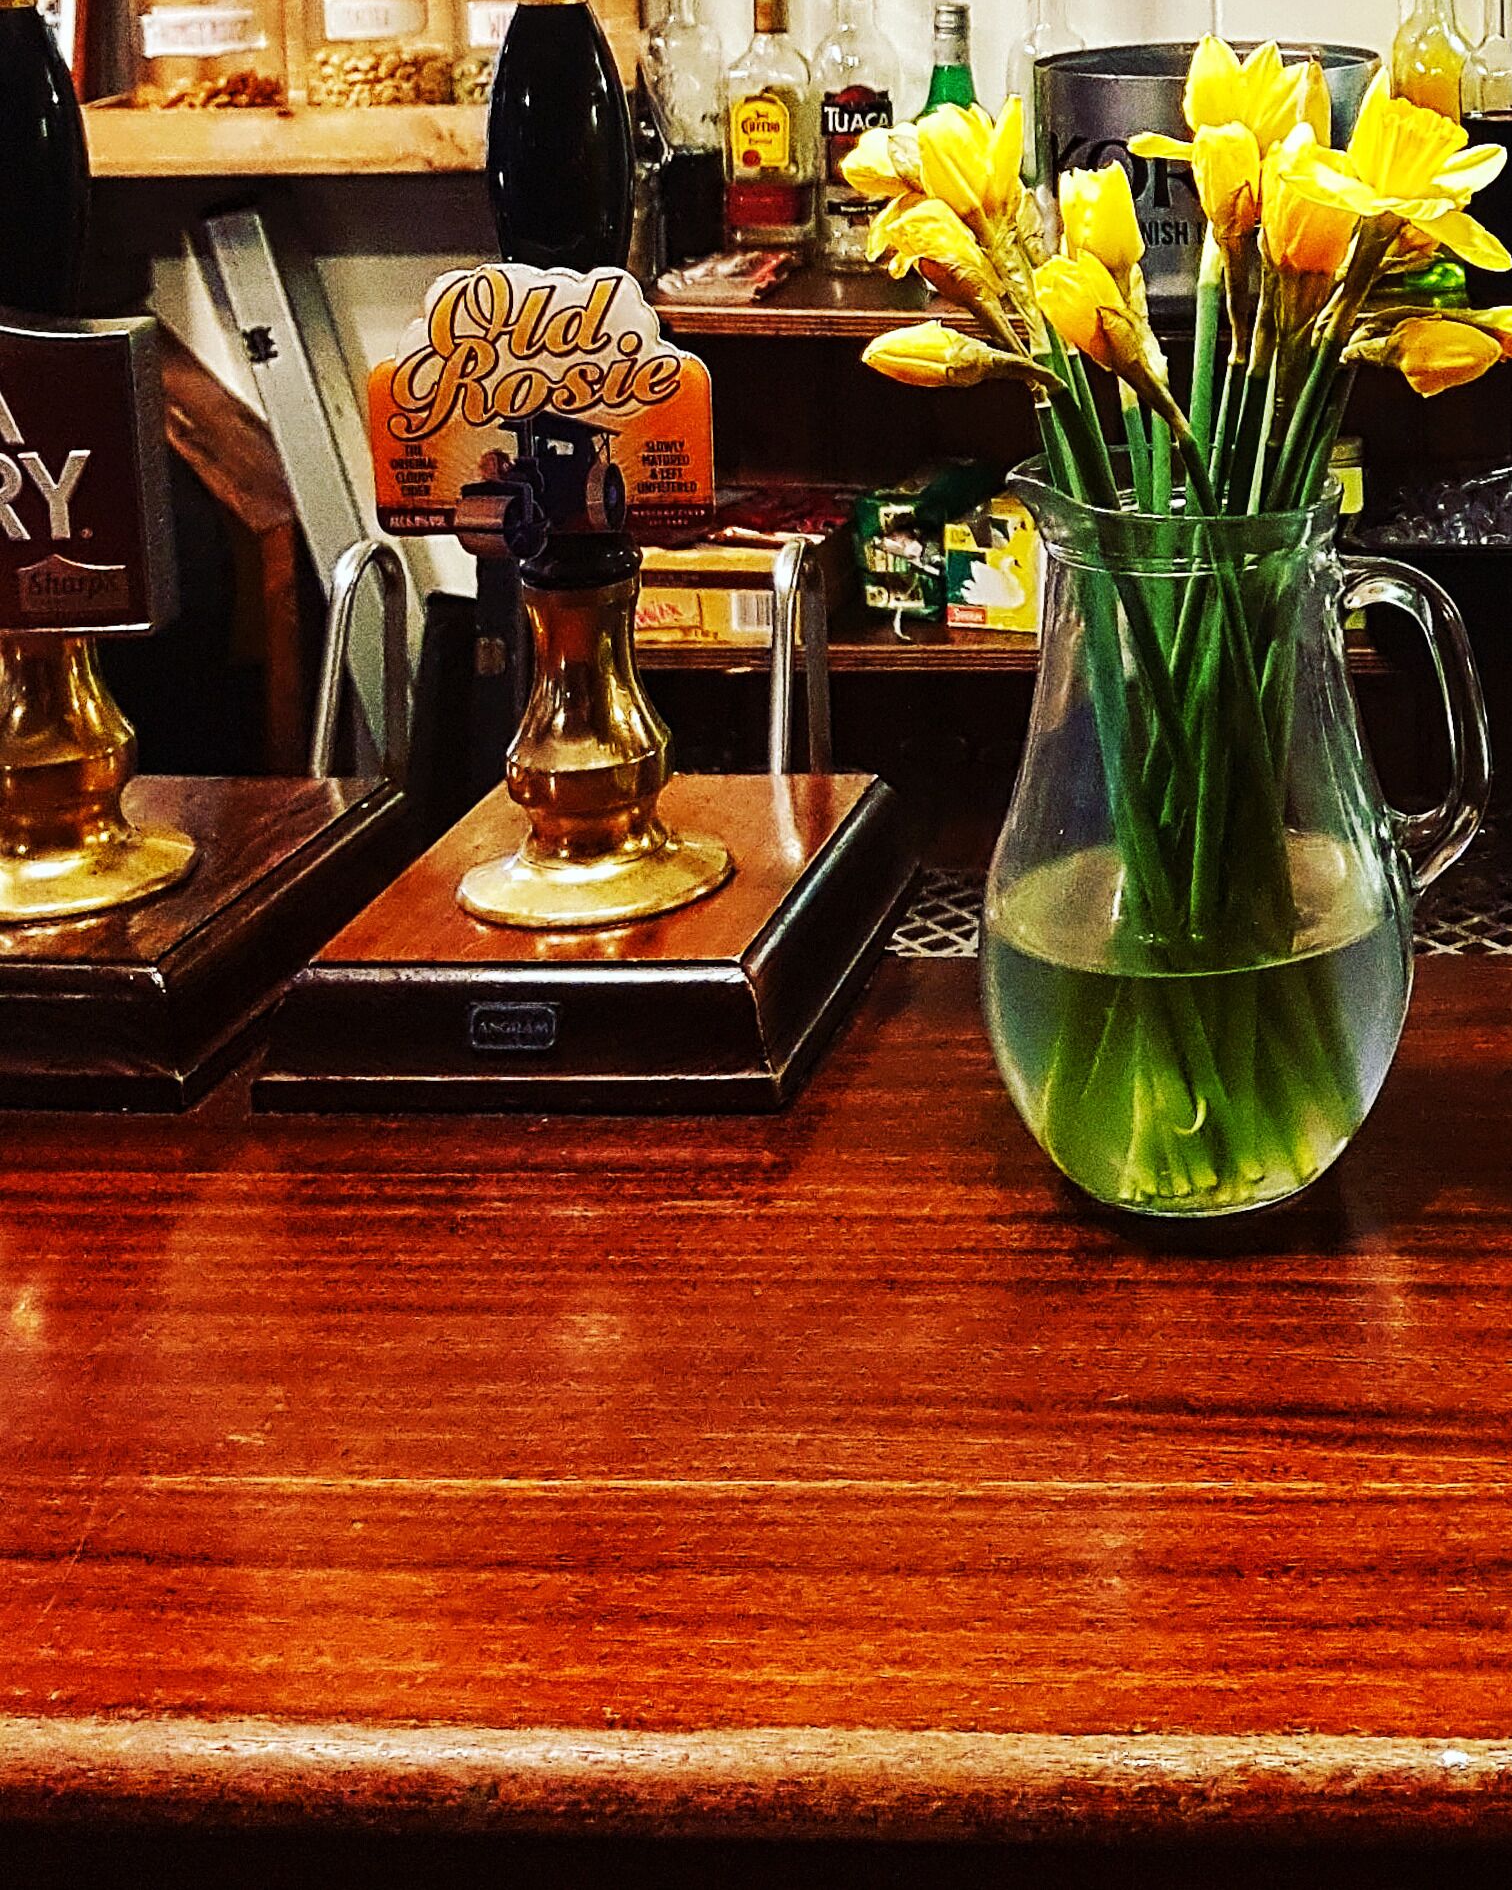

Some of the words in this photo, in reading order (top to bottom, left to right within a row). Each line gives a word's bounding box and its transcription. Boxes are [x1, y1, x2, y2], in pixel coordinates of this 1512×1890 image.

[823, 106, 889, 133] TUACA
[428, 267, 624, 361] Old
[386, 331, 682, 443] Rosie
